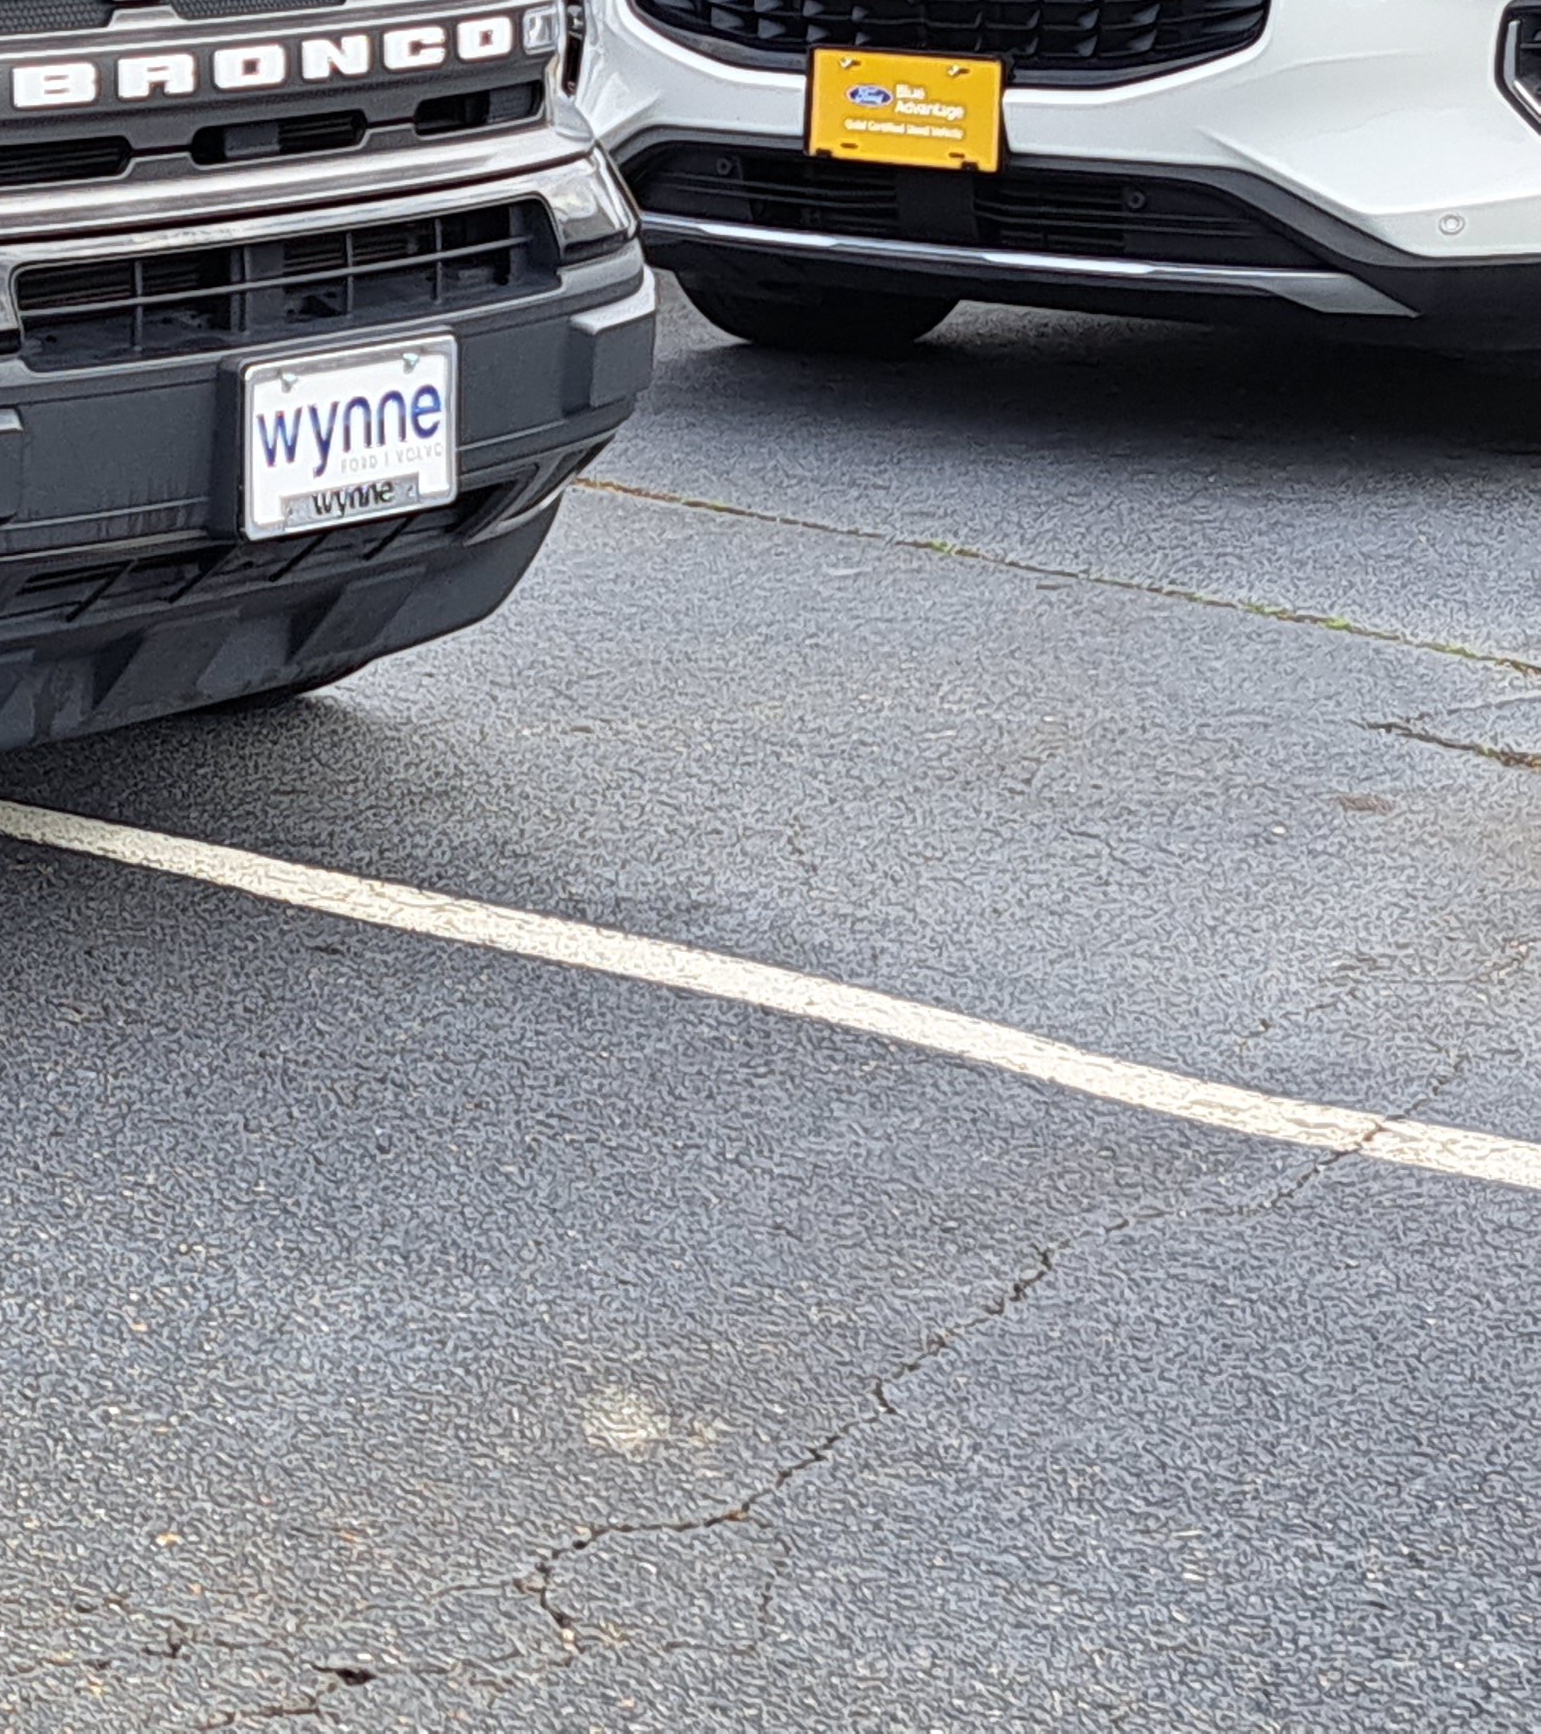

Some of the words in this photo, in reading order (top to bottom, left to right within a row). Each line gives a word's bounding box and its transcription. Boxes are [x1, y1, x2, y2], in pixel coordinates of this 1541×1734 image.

[12, 16, 513, 109] BRONCO
[895, 84, 926, 100] Blue
[895, 101, 965, 121] Advantage
[256, 384, 442, 478] wynne
[310, 480, 395, 516] wynne
